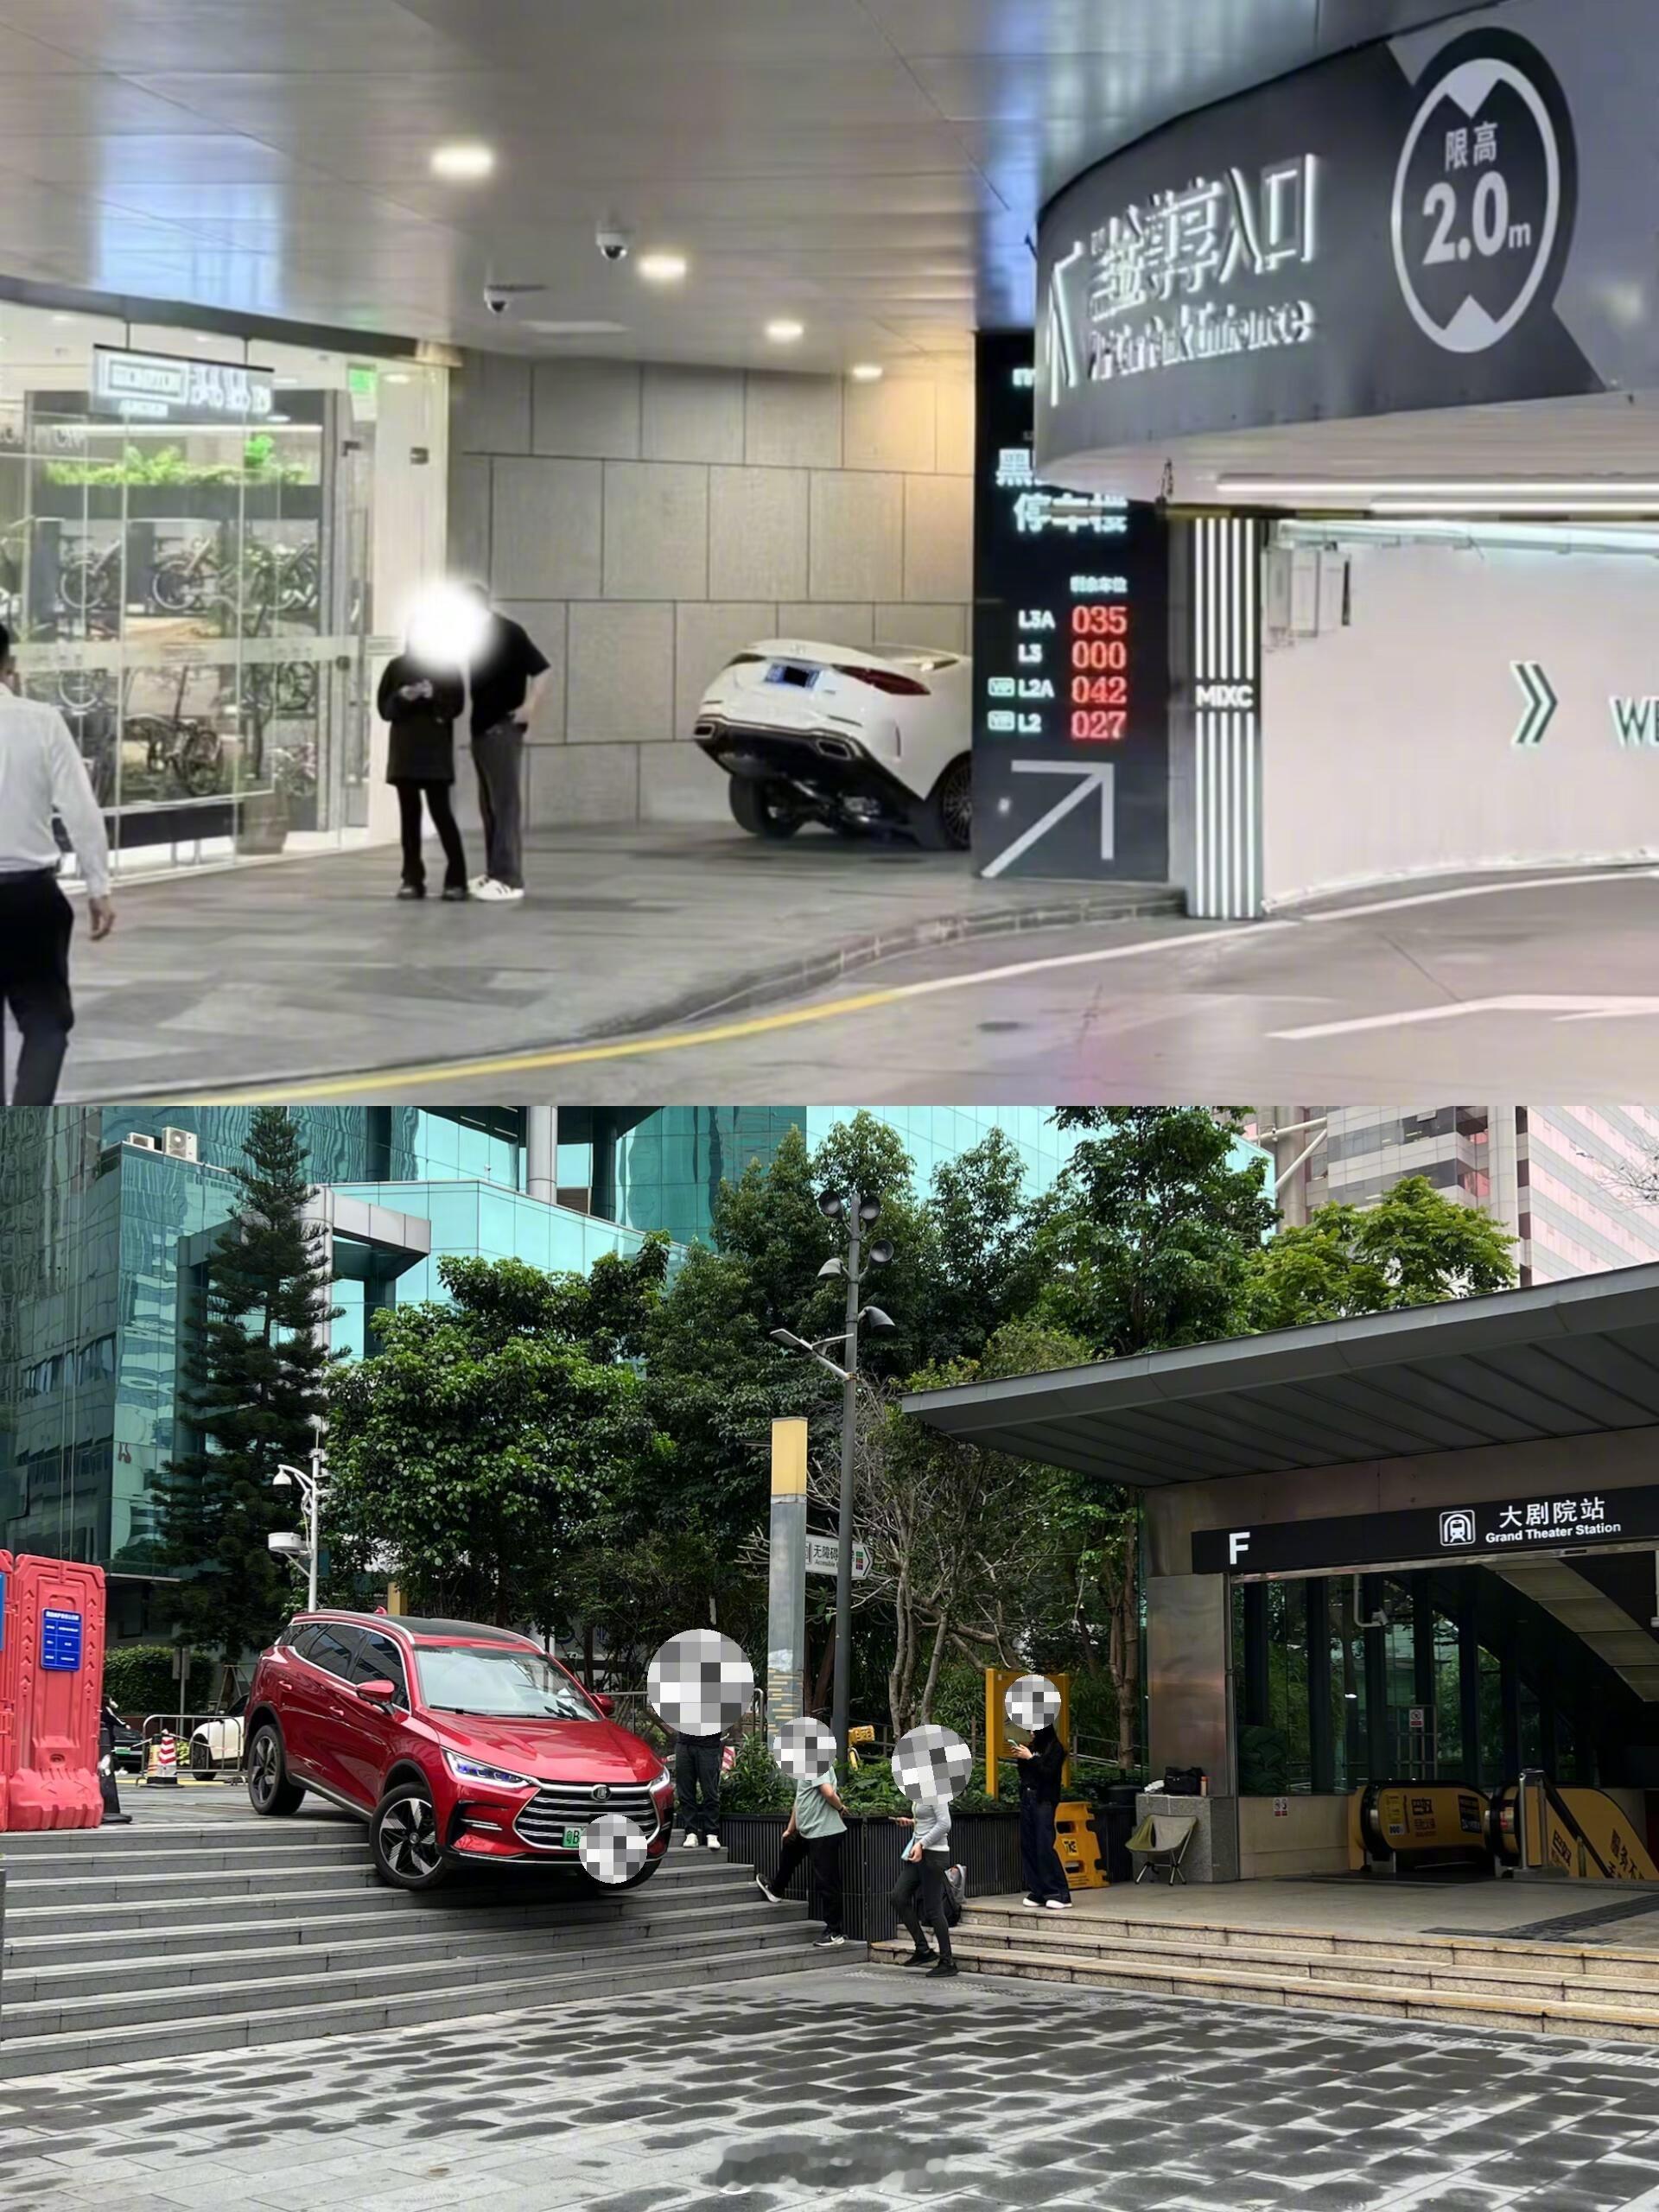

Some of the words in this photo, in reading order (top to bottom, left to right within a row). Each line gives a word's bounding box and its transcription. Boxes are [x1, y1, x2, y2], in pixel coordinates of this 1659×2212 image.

[1446, 121, 1497, 171] 限高
[1422, 171, 1531, 265] 2.0m
[1018, 609, 1056, 630] L3A
[1071, 606, 1128, 634] 035
[1018, 644, 1042, 664] L3
[1071, 640, 1127, 669] 000
[1018, 678, 1055, 698] L2A
[1071, 676, 1128, 704] 042
[1196, 684, 1254, 708] MIXC
[1018, 713, 1042, 733] L2
[1071, 710, 1127, 740] 027
[1499, 1497, 1605, 1529] 大剧院站
[1485, 1530, 1523, 1543] Grand
[1525, 1527, 1573, 1540] Theater
[1575, 1522, 1622, 1535] Station
[1229, 1531, 1250, 1565] F
